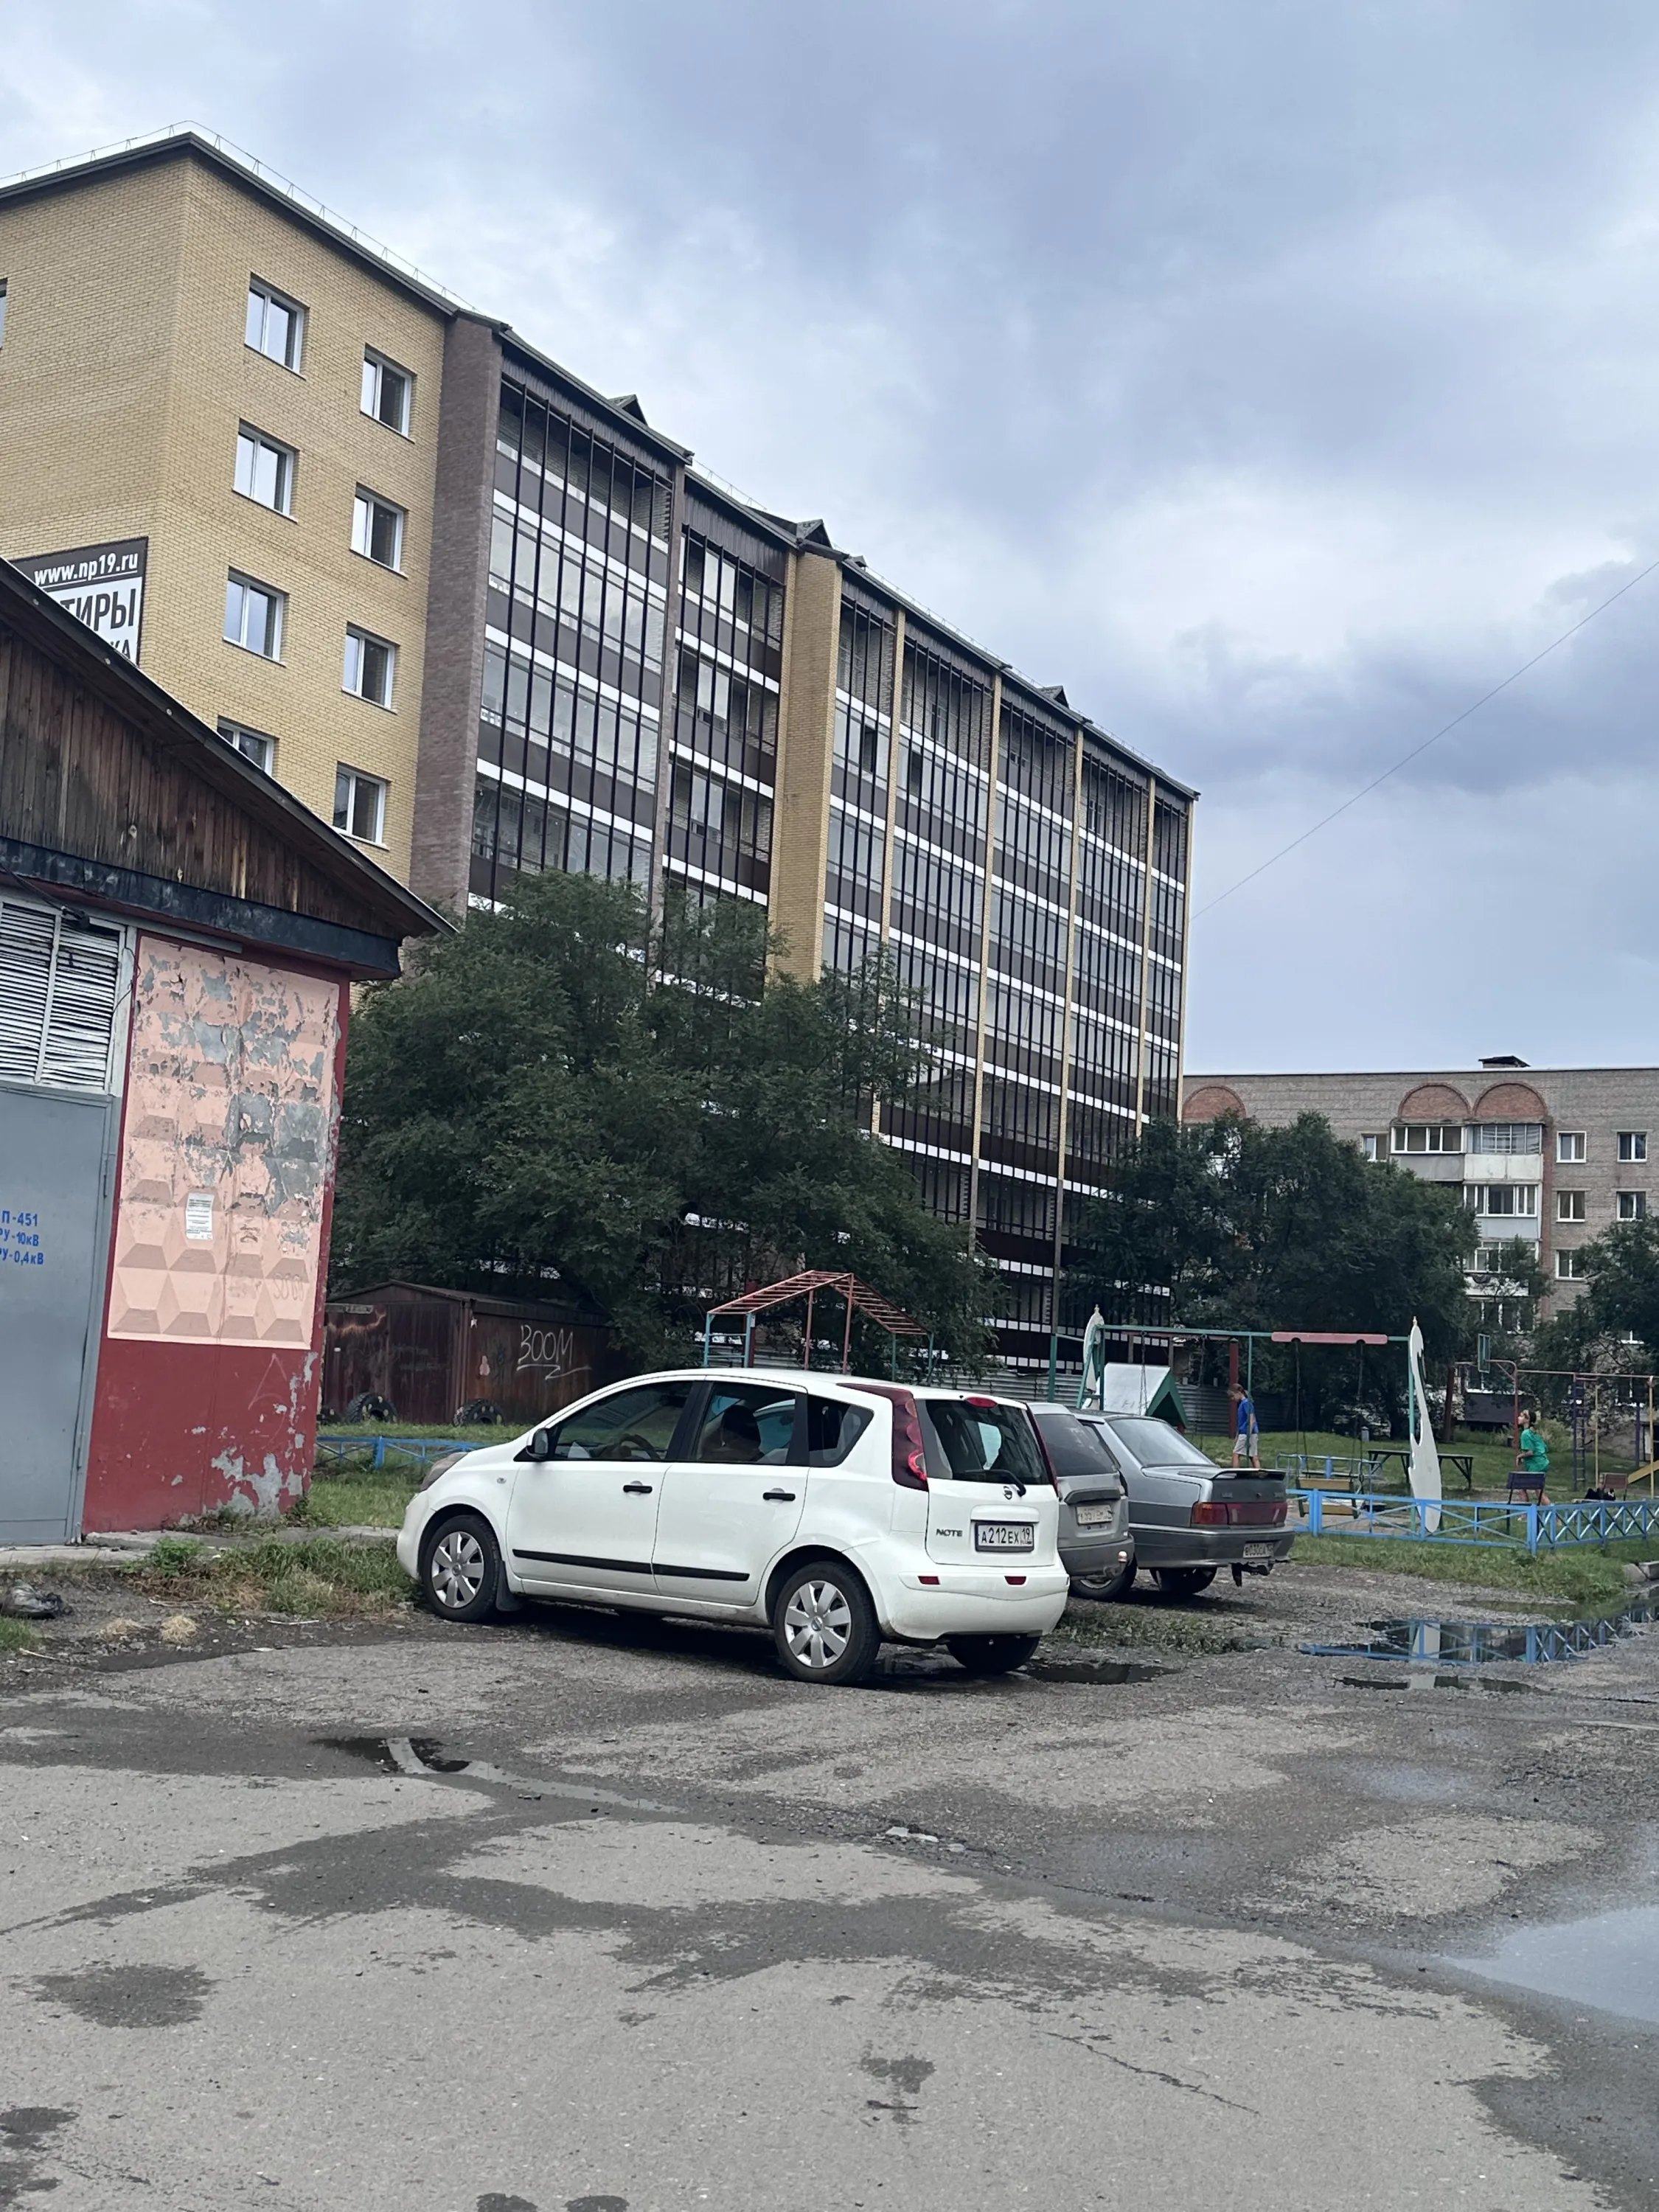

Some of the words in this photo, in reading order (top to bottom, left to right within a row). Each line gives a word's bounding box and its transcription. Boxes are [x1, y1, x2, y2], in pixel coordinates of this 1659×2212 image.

[34, 553, 139, 585] www.np19.ru
[0, 1248, 44, 1266] У-0,4кВ
[936, 1528, 963, 1537] NOTE
